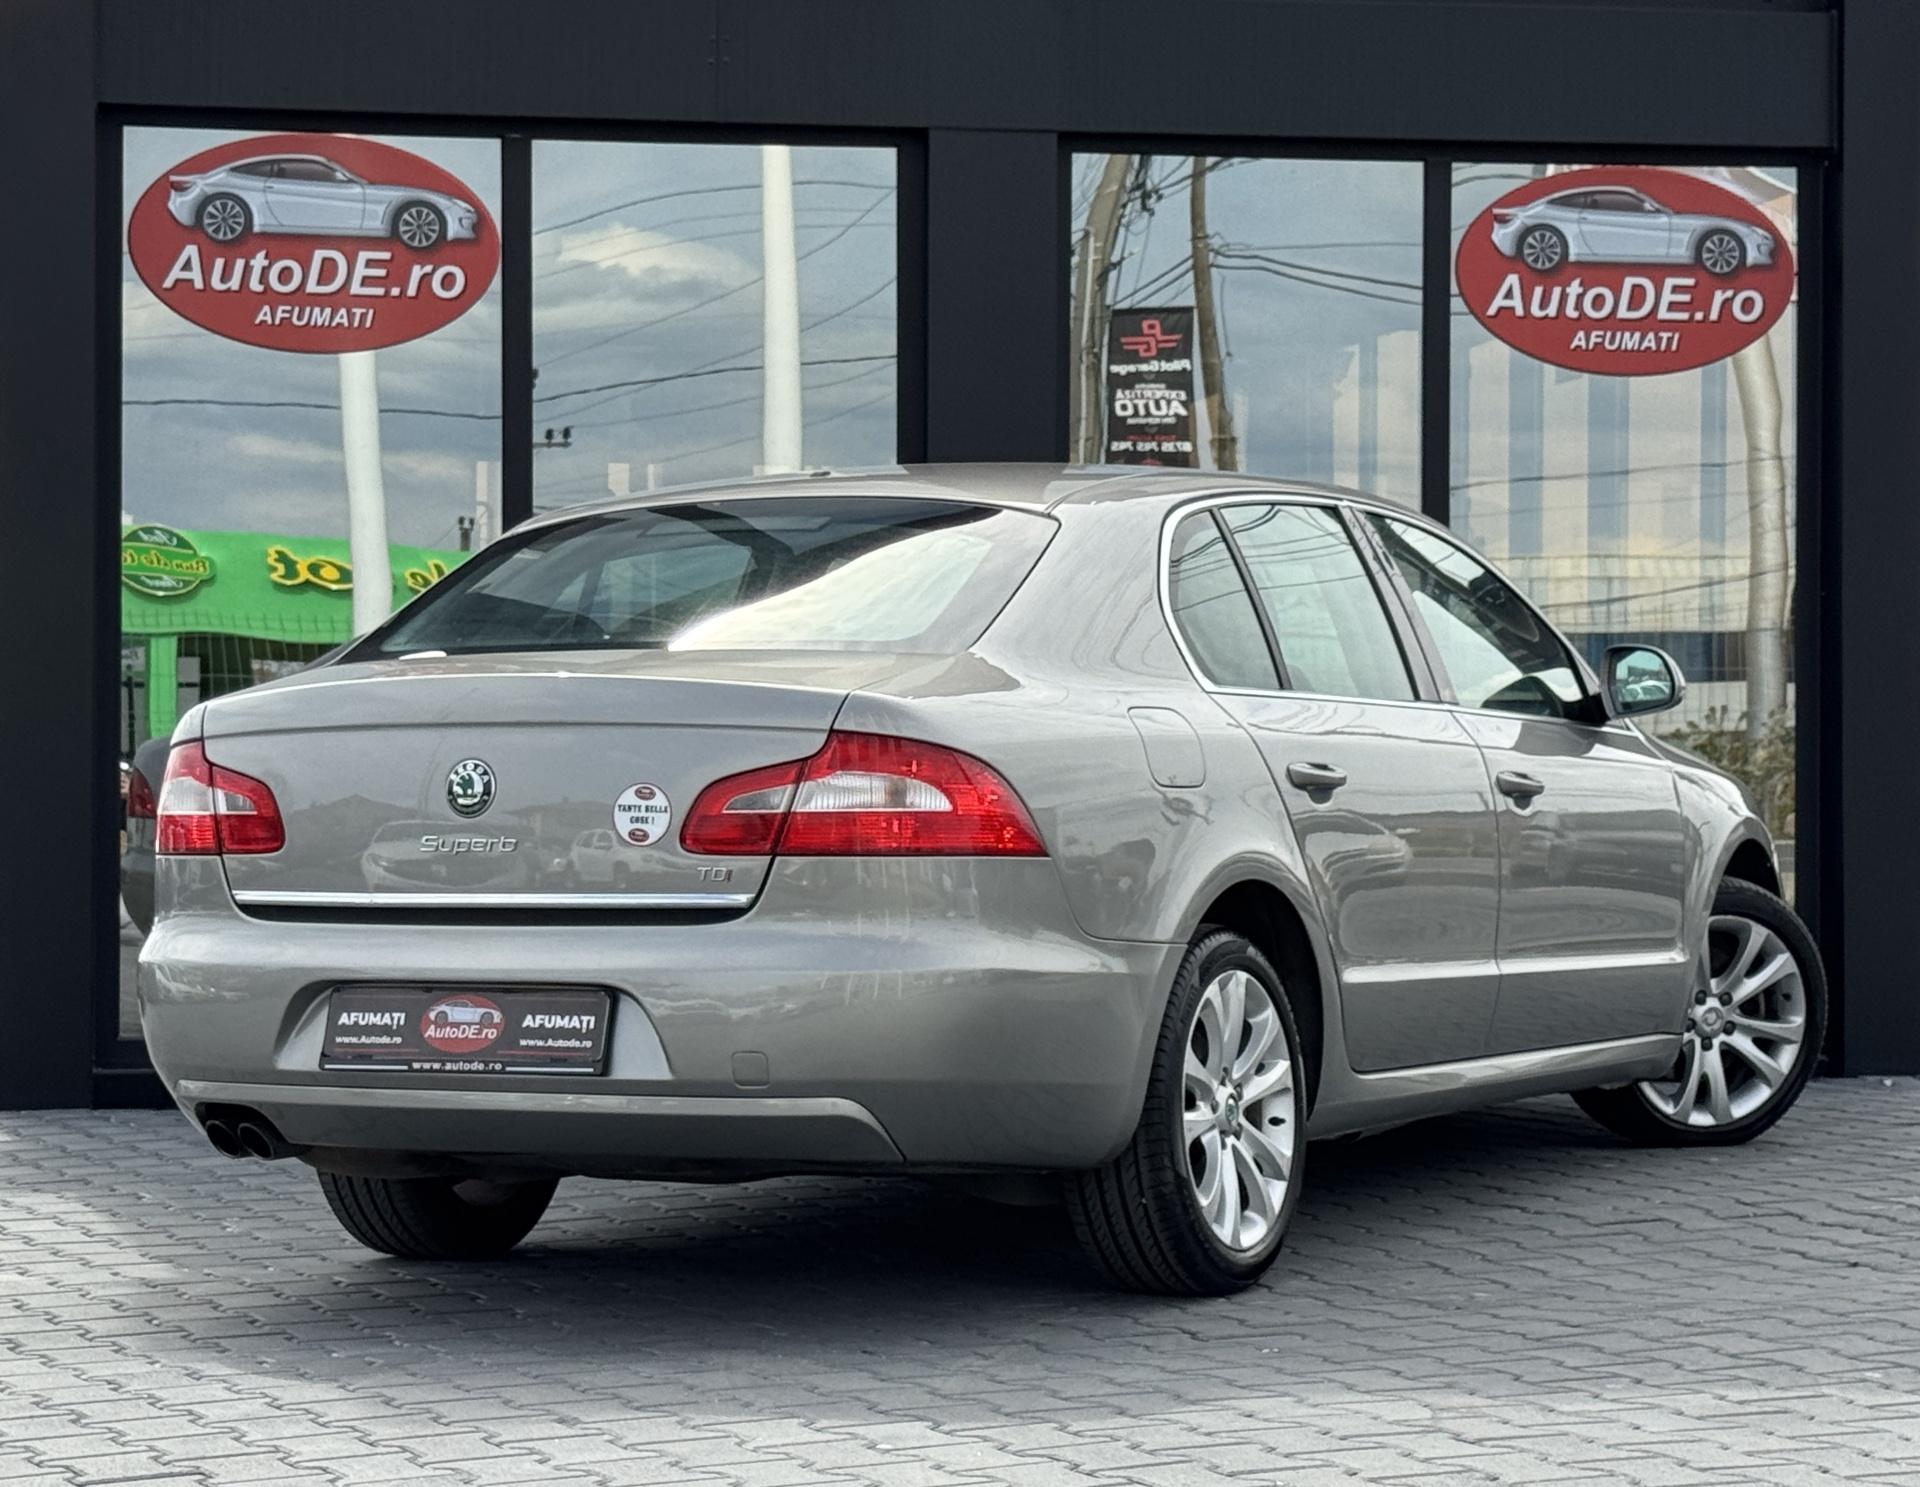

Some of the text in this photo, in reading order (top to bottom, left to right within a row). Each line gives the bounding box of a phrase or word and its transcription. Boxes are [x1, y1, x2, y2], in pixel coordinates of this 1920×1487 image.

[162, 244, 467, 300] AutoDE.ro
[1486, 273, 1765, 323] AutoDE.ro
[254, 304, 375, 329] AFUMATI
[1569, 330, 1680, 352] AFUMATI
[419, 835, 518, 856] Superb
[697, 866, 733, 883] TDI
[423, 1024, 498, 1040] AutoDE.ro
[412, 1061, 503, 1072] www.autode.ro
